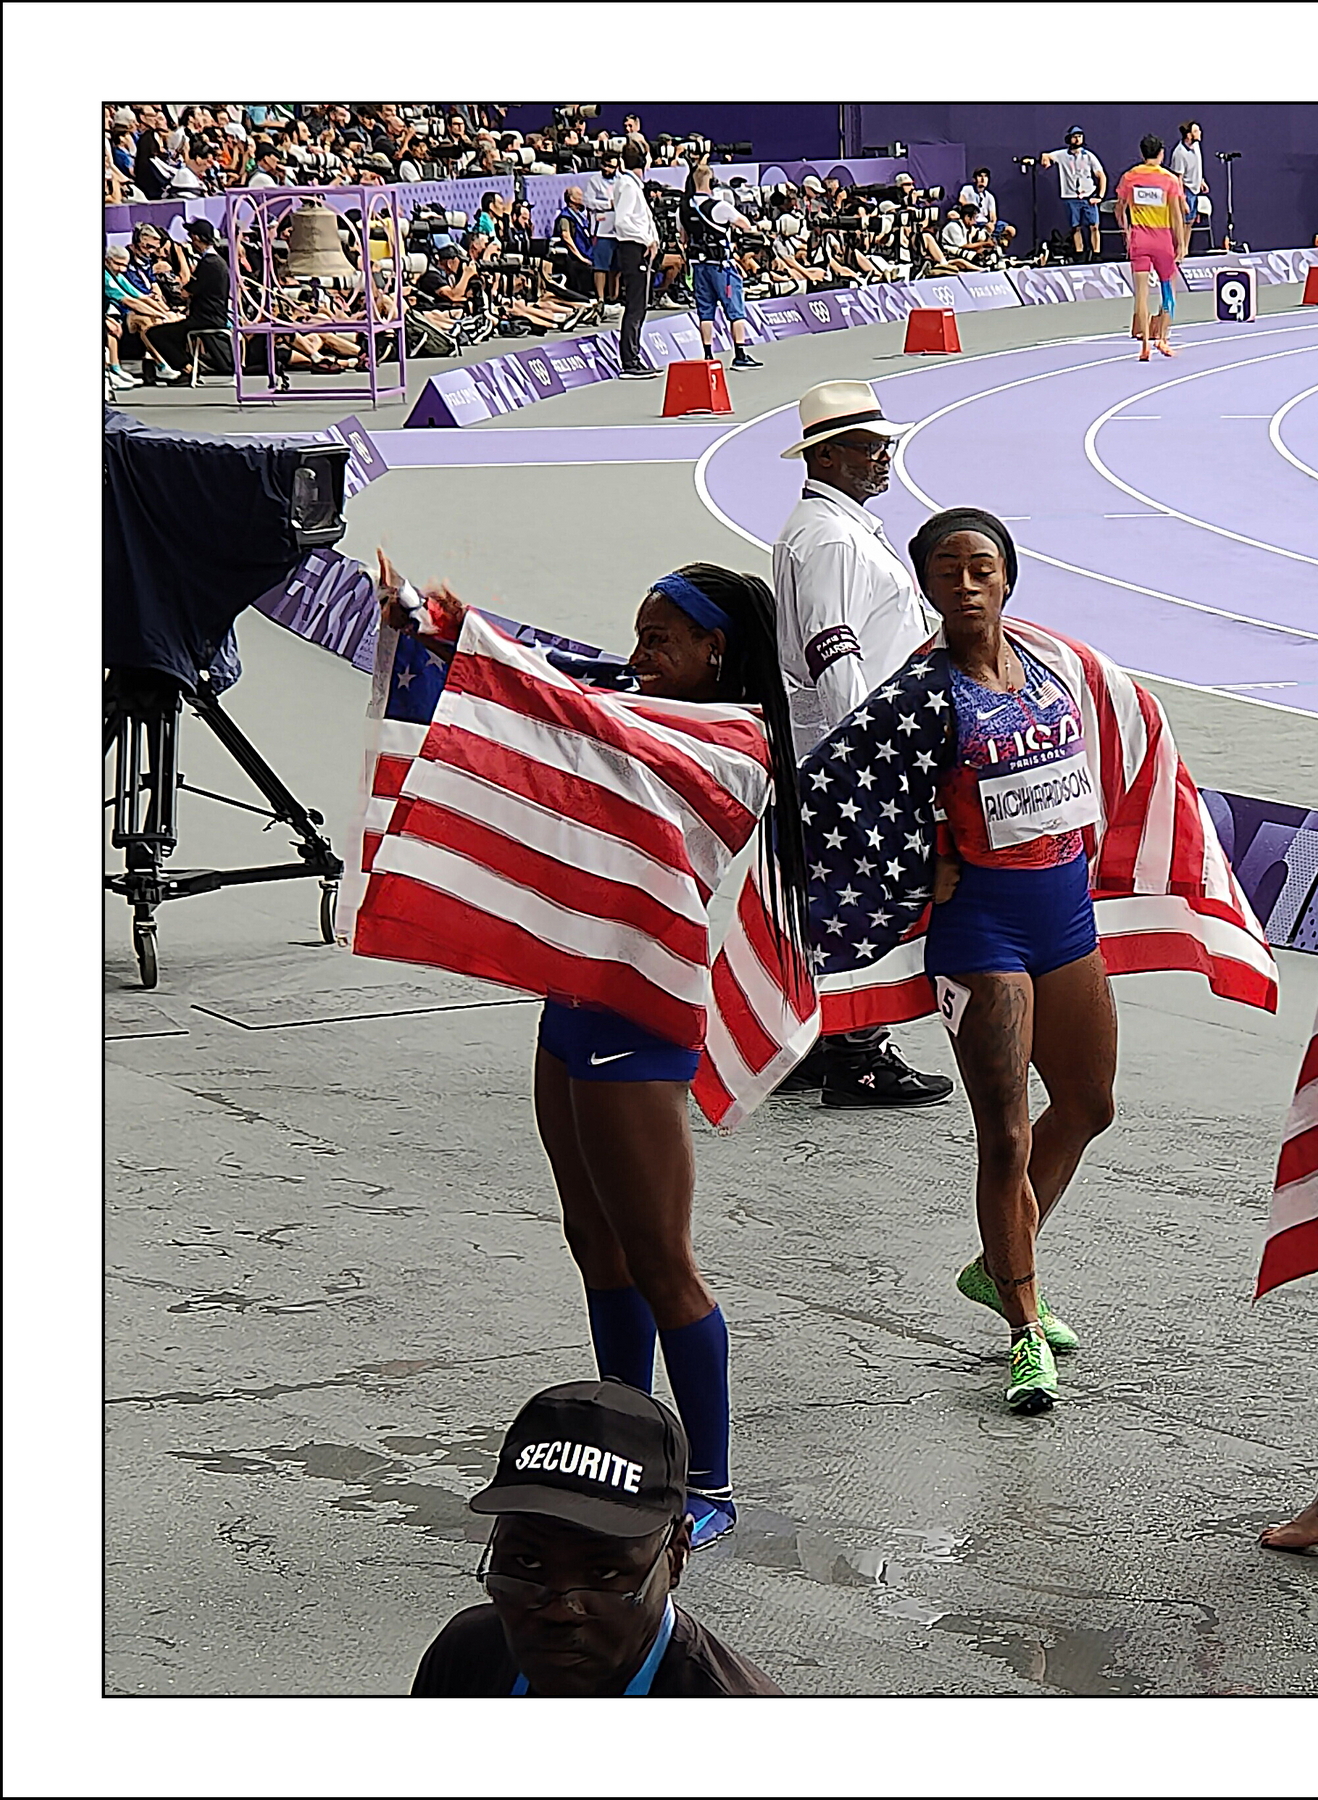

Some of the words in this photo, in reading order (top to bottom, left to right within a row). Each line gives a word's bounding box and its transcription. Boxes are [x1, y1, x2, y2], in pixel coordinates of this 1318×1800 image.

[1221, 280, 1246, 315] 9
[1009, 755, 1039, 770] PARIS
[984, 766, 1092, 822] RICHARDSON
[942, 987, 956, 1020] 5
[515, 1441, 643, 1494] SECURITE
